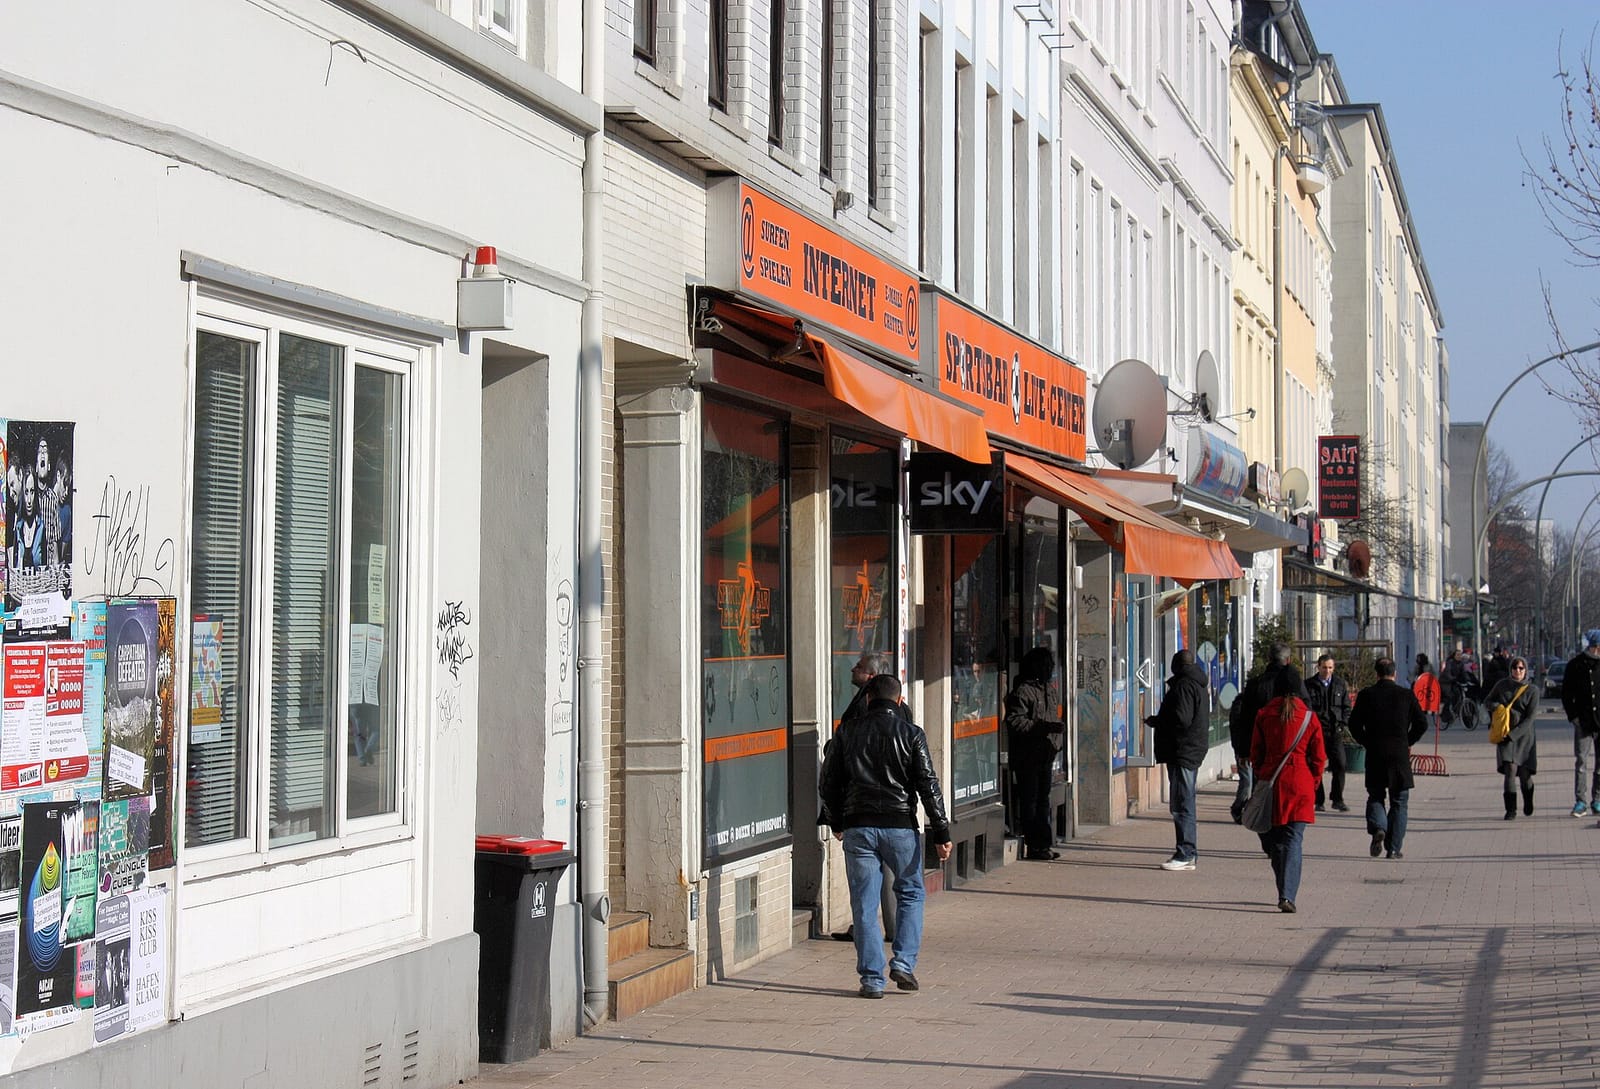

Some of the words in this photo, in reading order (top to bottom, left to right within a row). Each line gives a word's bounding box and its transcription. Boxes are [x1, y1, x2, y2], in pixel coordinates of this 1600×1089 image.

[761, 219, 790, 251] SURFEN
[760, 256, 792, 288] SPIELEN
[803, 242, 876, 322] INTERNET
[920, 471, 993, 515] sky
[118, 660, 146, 683] DEFEATER
[155, 748, 166, 758] 2011
[116, 858, 146, 875] JUNGLE
[140, 907, 157, 927] KISS
[140, 923, 157, 943] KISS
[139, 940, 157, 958] CLUB
[136, 971, 160, 992] HAFEN
[135, 986, 160, 1006] KLANG
